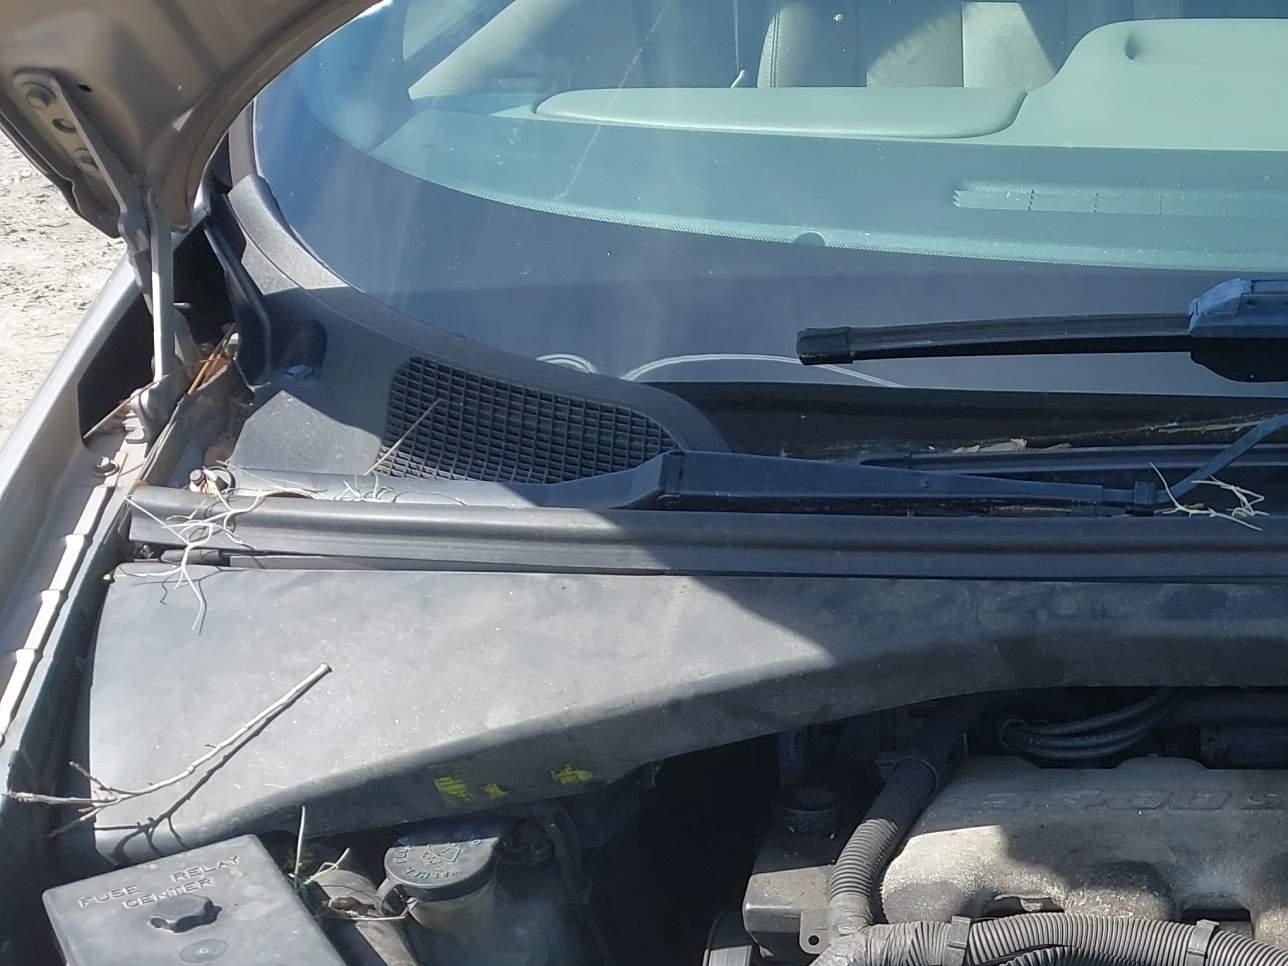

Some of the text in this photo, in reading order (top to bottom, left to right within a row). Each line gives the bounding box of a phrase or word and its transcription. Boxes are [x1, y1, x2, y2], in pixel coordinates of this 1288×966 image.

[78, 855, 240, 908] FUSE RELAY
[122, 877, 216, 909] CENTER
